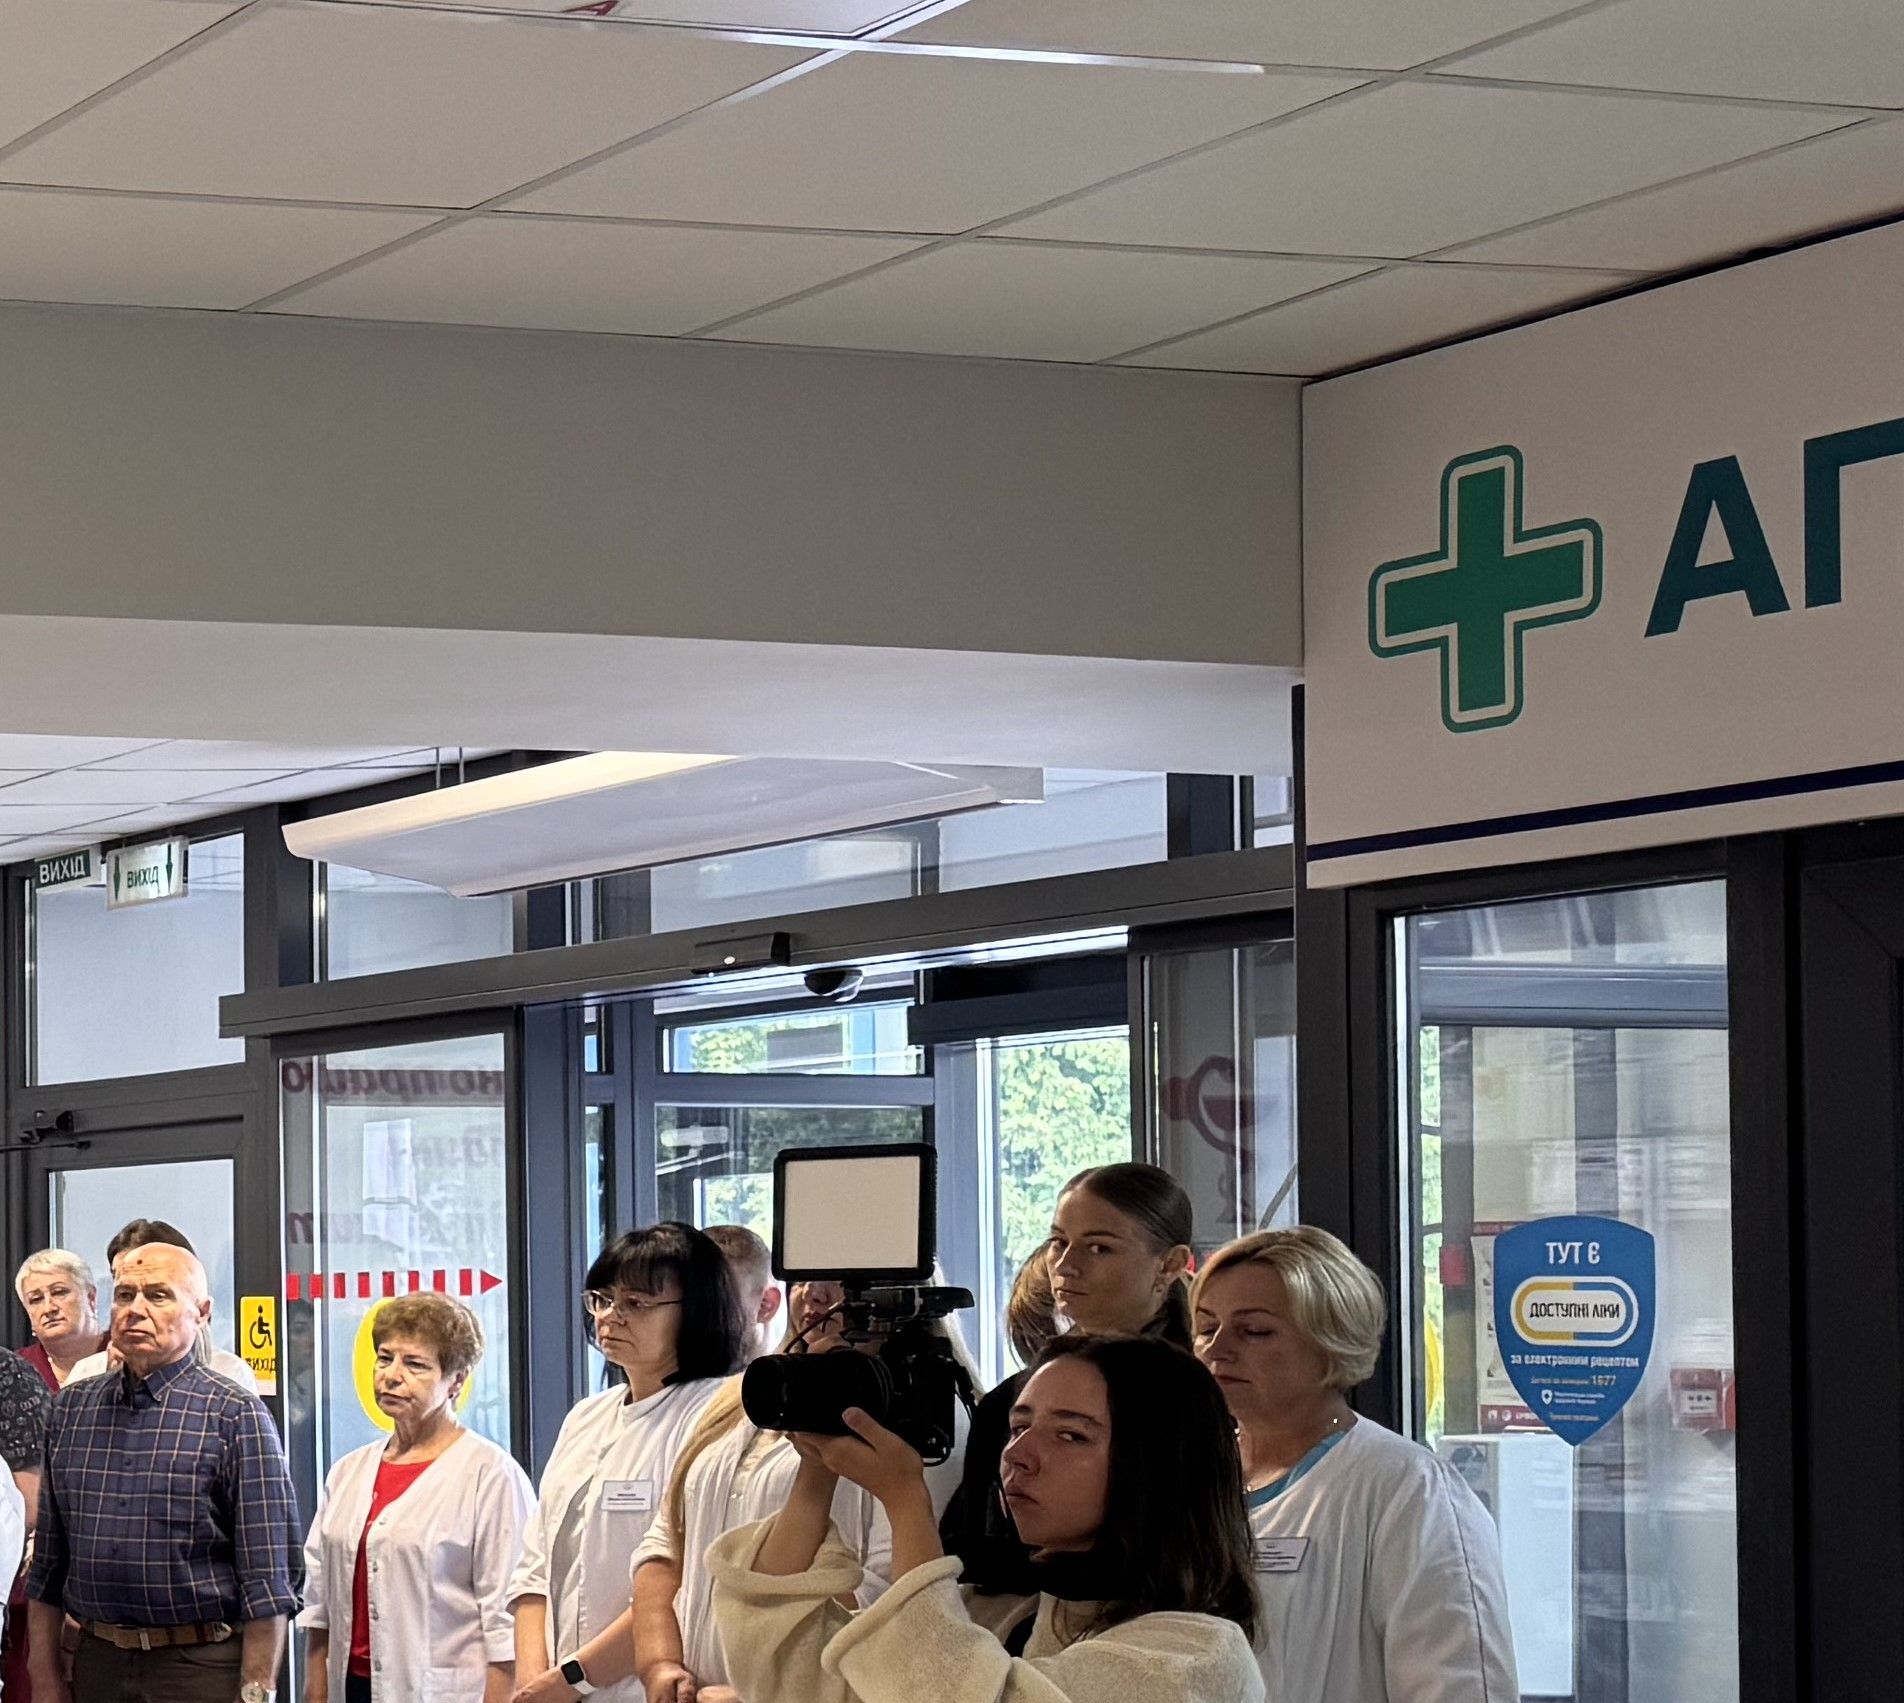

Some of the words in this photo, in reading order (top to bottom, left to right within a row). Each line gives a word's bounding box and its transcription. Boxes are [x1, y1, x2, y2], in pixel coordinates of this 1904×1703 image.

[39, 854, 85, 884] ВИХІД
[127, 865, 159, 889] ВИХІД
[1545, 1241, 1583, 1264] ТУТ
[1588, 1241, 1600, 1264] Є
[1530, 1302, 1589, 1318] ДОСТУПНІ
[1592, 1303, 1620, 1318] ЛІКИ
